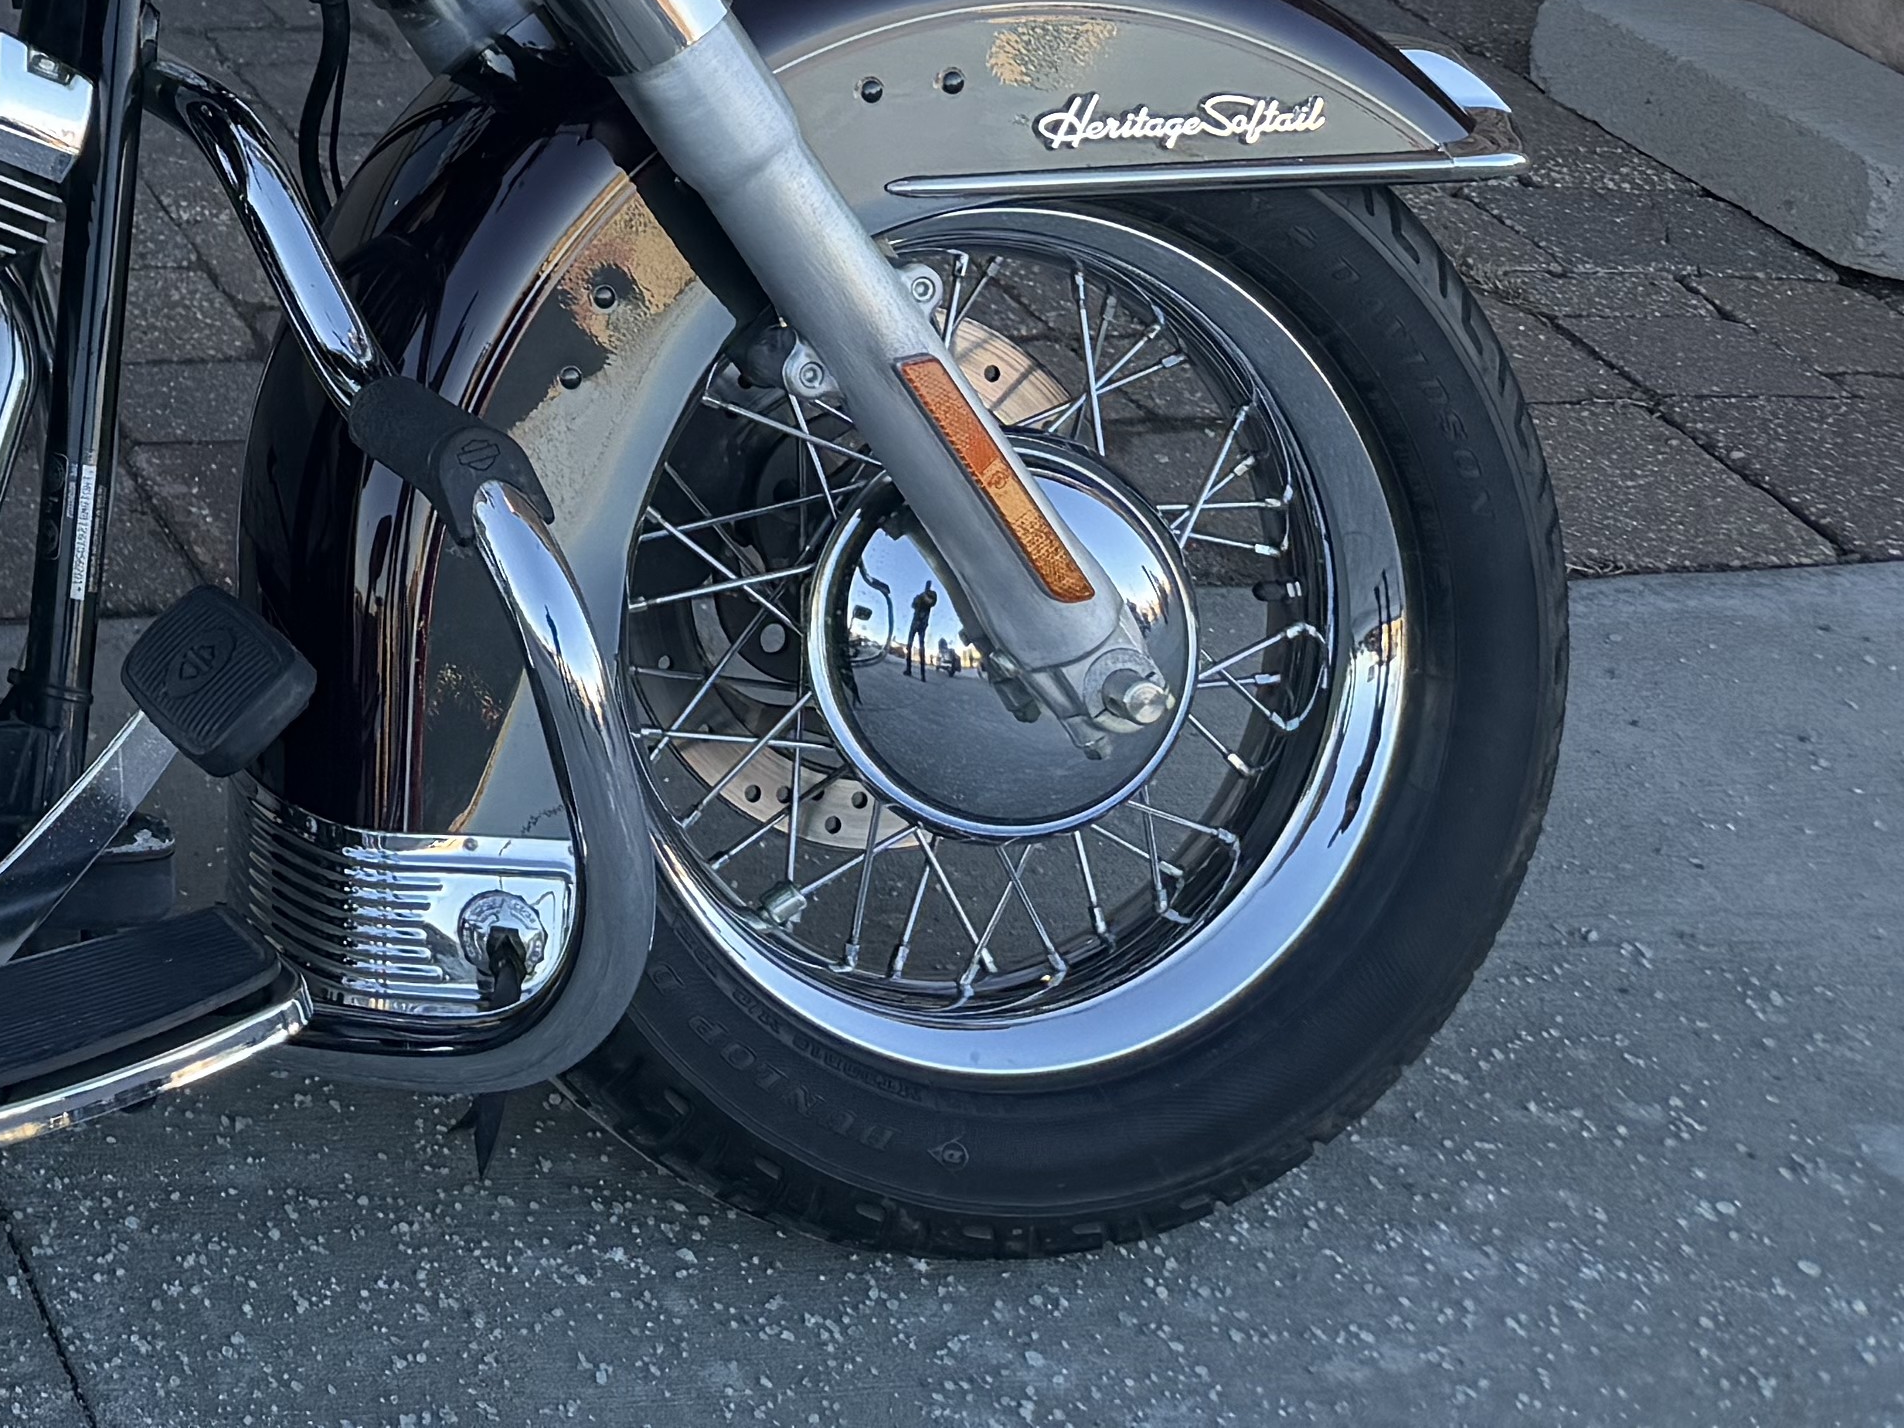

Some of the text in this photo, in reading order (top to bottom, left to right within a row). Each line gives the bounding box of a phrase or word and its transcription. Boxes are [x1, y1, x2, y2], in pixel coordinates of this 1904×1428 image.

[1038, 93, 1326, 149] Heritage Softail
[689, 1014, 903, 1152] DUNLOP
